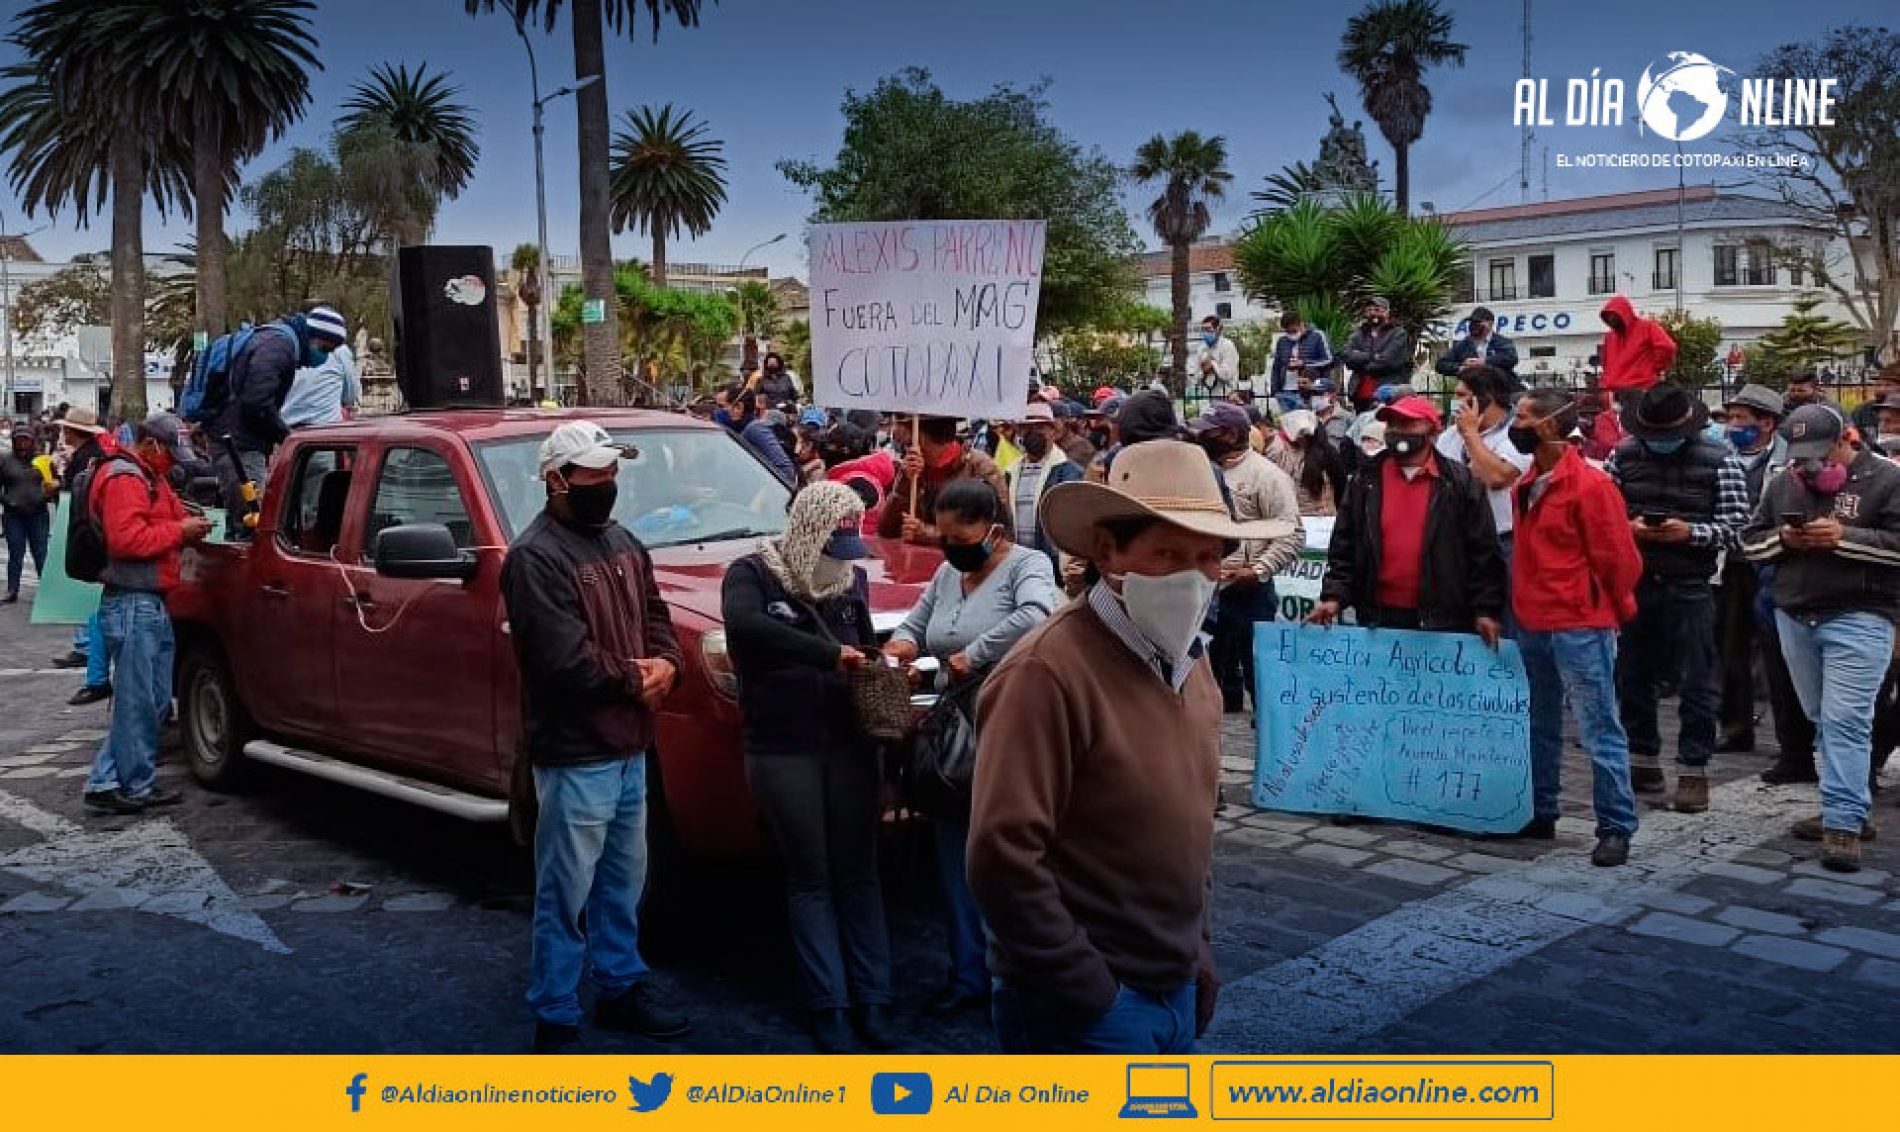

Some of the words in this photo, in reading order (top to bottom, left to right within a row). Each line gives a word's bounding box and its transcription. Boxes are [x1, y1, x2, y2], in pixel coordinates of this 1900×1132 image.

[818, 226, 920, 274] ALEXIS
[911, 302, 943, 326] DEL
[954, 279, 1030, 331] MAG
[1430, 311, 1571, 337] CAPECO
[838, 341, 1003, 402] COTOPAXI
[1278, 629, 1297, 664] El
[1310, 634, 1371, 668] sector
[1488, 664, 1515, 680] es
[1280, 674, 1299, 705] el
[1310, 675, 1400, 706] sustento
[1408, 679, 1433, 705] de
[1400, 766, 1421, 793] #
[1435, 769, 1481, 801] 177
